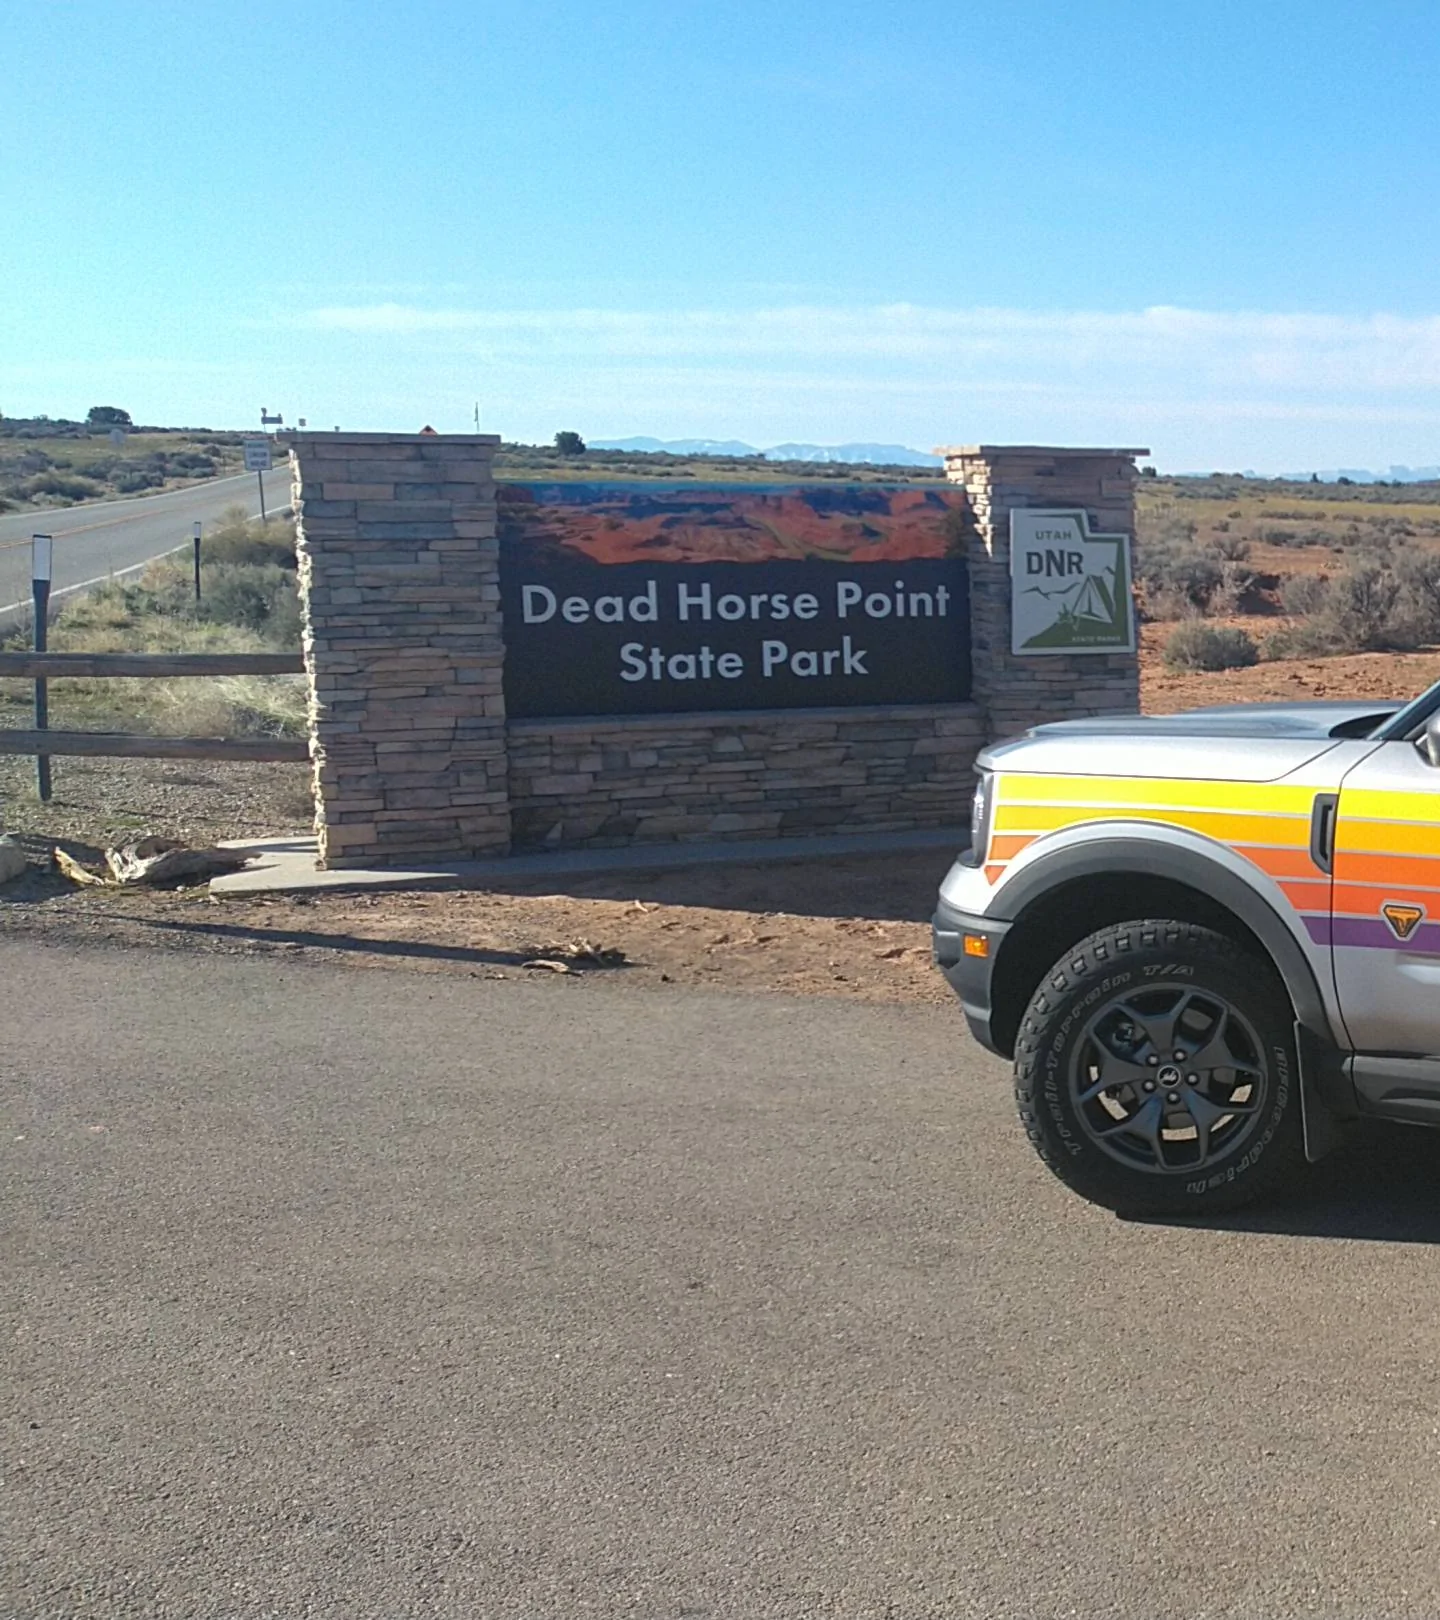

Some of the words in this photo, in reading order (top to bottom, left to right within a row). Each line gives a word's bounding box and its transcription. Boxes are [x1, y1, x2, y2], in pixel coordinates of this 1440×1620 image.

[1035, 530, 1072, 541] UTAH
[1026, 549, 1084, 578] DNR
[522, 580, 658, 624] Dead
[677, 582, 820, 621] Horse
[837, 579, 951, 619] Point
[619, 642, 744, 682] State
[762, 635, 869, 677] Park
[1143, 963, 1195, 977] T/A
